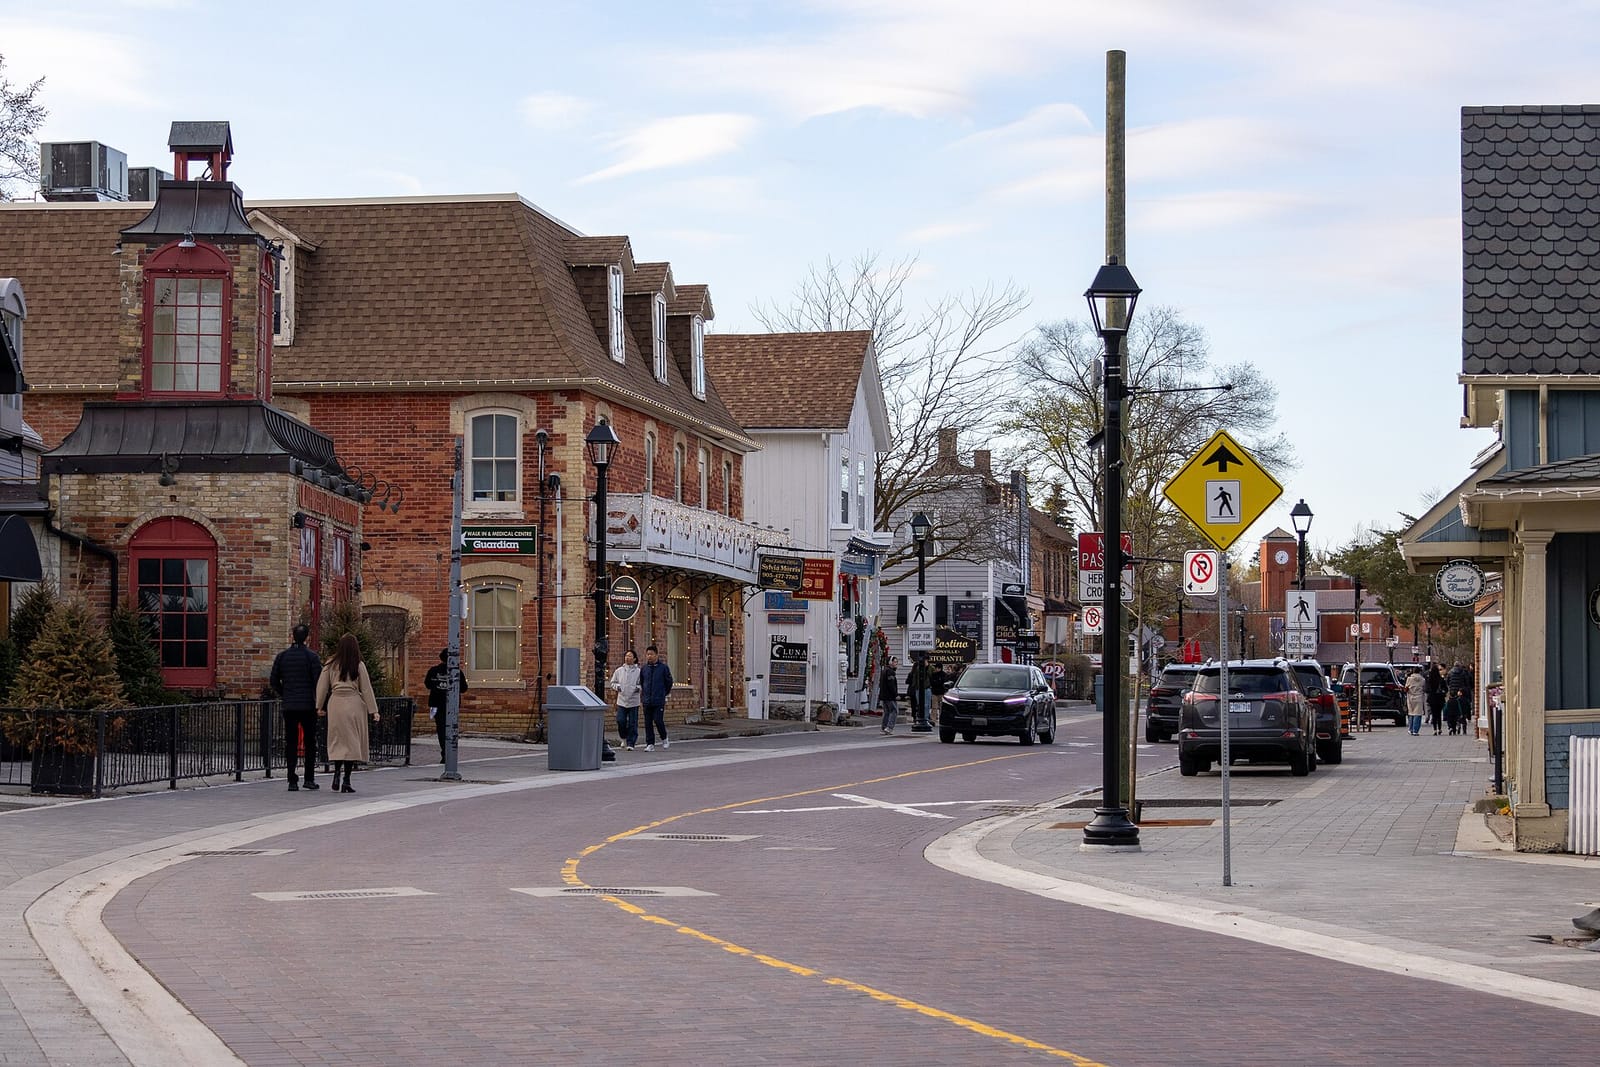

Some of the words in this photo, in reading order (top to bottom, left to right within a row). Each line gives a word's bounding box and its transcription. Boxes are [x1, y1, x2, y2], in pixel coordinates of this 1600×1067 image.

[473, 540, 519, 549] Guardian
[762, 563, 780, 571] Sylvia
[781, 564, 801, 573] Morris
[1088, 573, 1104, 584] HER
[783, 648, 807, 656] LUNA
[1045, 665, 1061, 675] DQ
